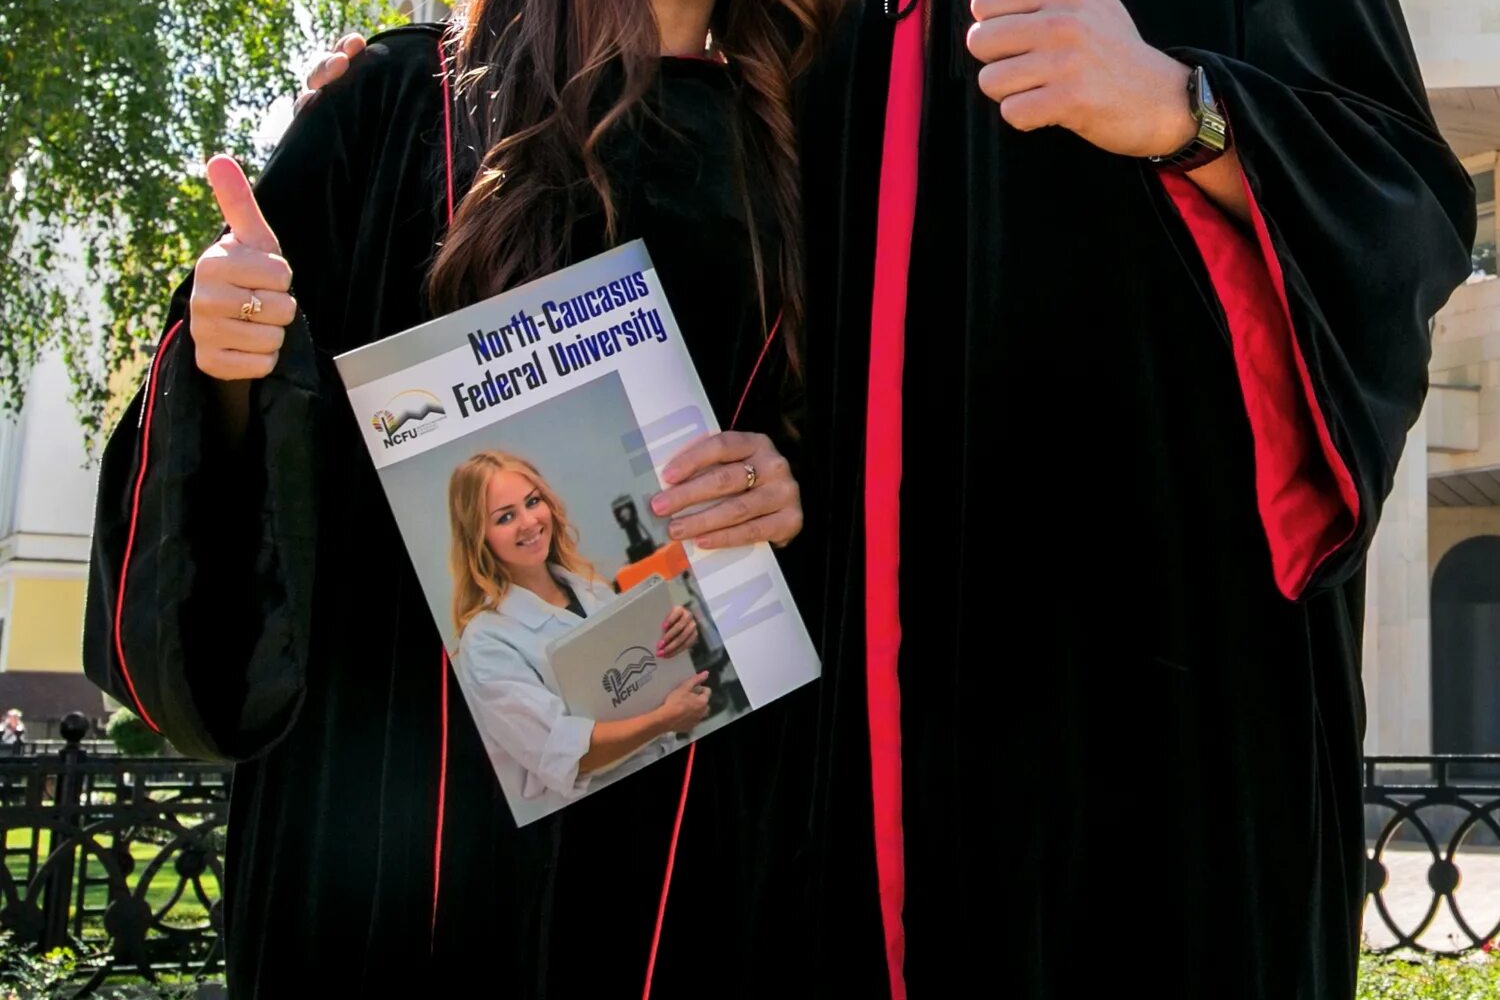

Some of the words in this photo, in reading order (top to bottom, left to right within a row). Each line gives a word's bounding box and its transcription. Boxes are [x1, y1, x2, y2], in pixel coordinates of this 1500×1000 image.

[467, 271, 650, 366] North-Caucasus
[451, 350, 548, 419] Federal
[548, 307, 668, 378] University
[383, 427, 418, 449] NCFU
[611, 680, 640, 709] NCFU
